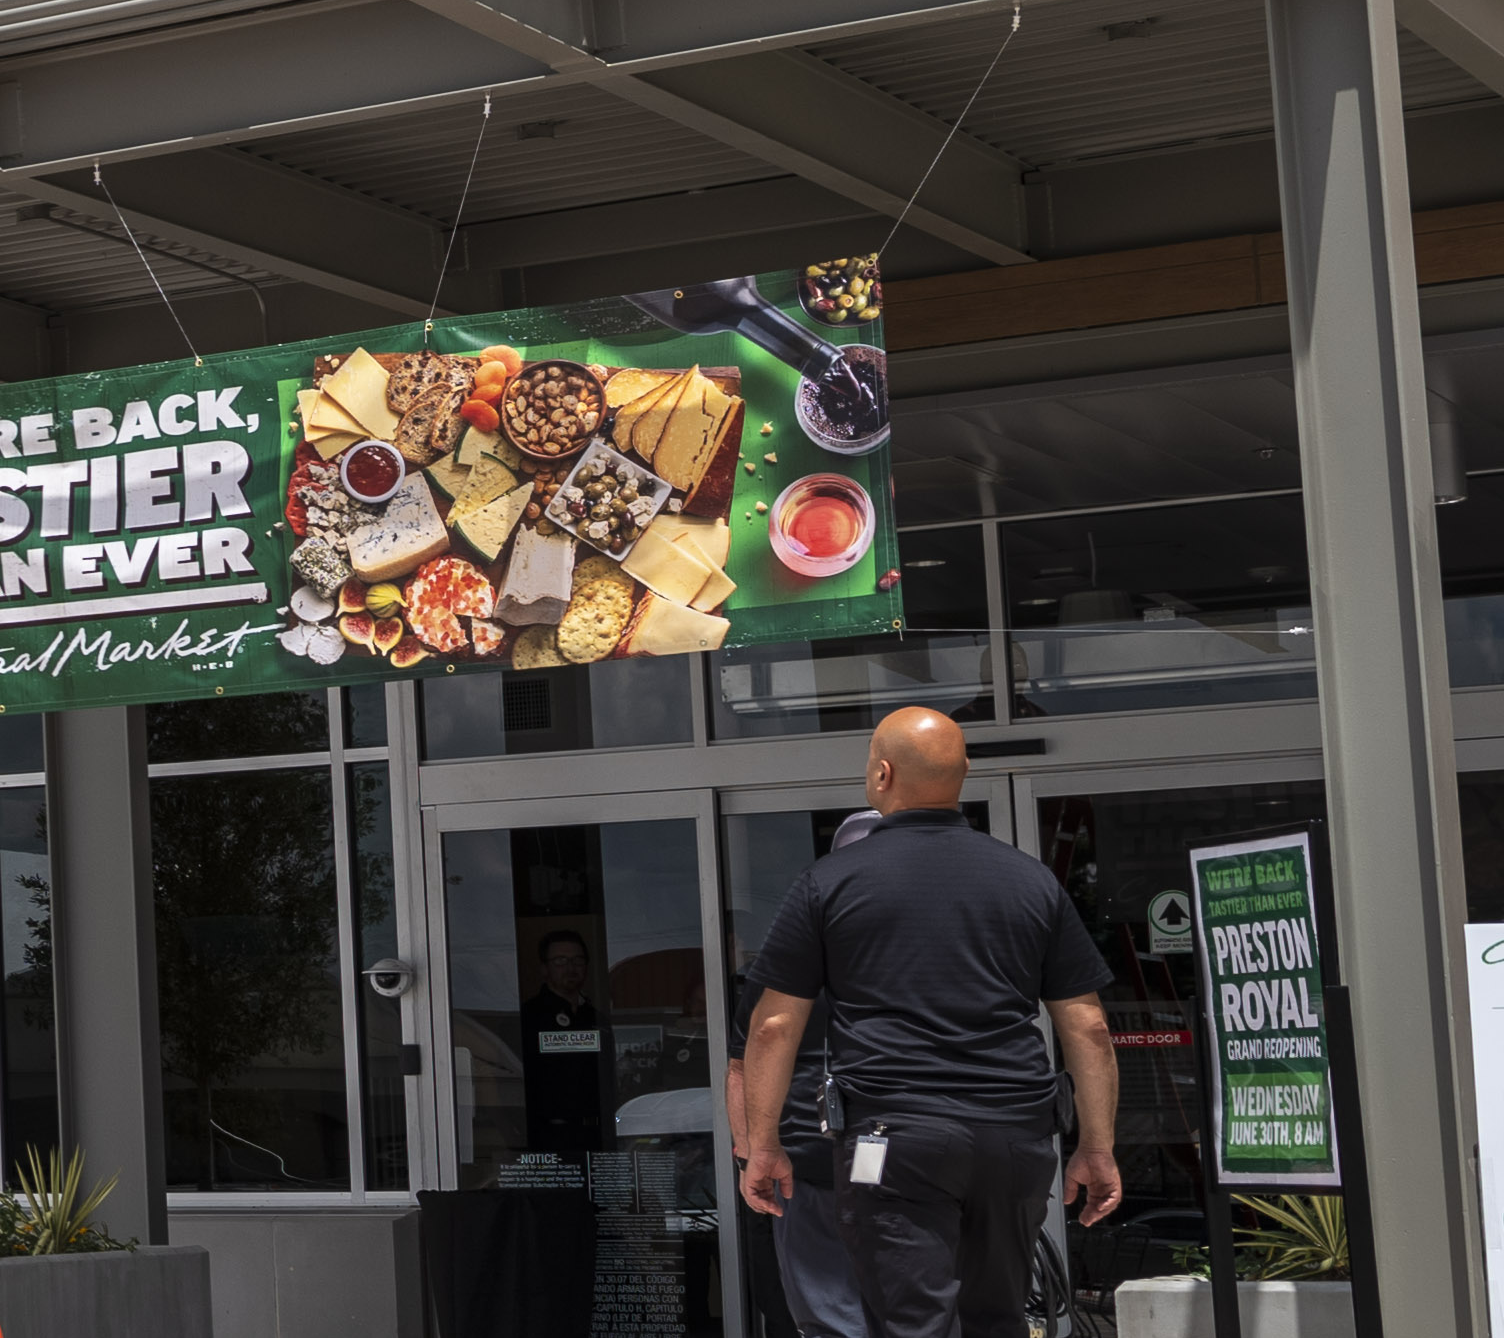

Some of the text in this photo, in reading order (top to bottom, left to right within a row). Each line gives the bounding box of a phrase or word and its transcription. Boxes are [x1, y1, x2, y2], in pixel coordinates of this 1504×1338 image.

[70, 385, 262, 448] BACK,
[63, 526, 255, 594] EVER
[51, 618, 287, 678] Market
[1204, 860, 1301, 893] WE'RE BACK,
[1208, 890, 1304, 919] TASTIER THAN EVER
[1211, 916, 1313, 977] PRESTON
[1219, 976, 1319, 1033] ROYAL
[544, 1032, 595, 1042] STAND CLEAR
[1110, 1034, 1182, 1045] MATIC DOOR
[1226, 1034, 1322, 1062] GRAND REOPENING
[1231, 1083, 1321, 1118] WEDNESDAY
[1229, 1120, 1324, 1148] JUNE 30TH, 8 AM
[617, 1285, 646, 1294] ARMAS
[646, 1285, 657, 1294] DE
[658, 1285, 686, 1294] FUEGO
[629, 1275, 644, 1284] DEL
[617, 1294, 660, 1304] PERSONAS
[661, 1294, 679, 1303] CON
[619, 1323, 640, 1333] ESTA
[641, 1323, 686, 1333] PROPIEDAD
[631, 1313, 642, 1323] DE
[646, 1313, 678, 1323] PORTAR
